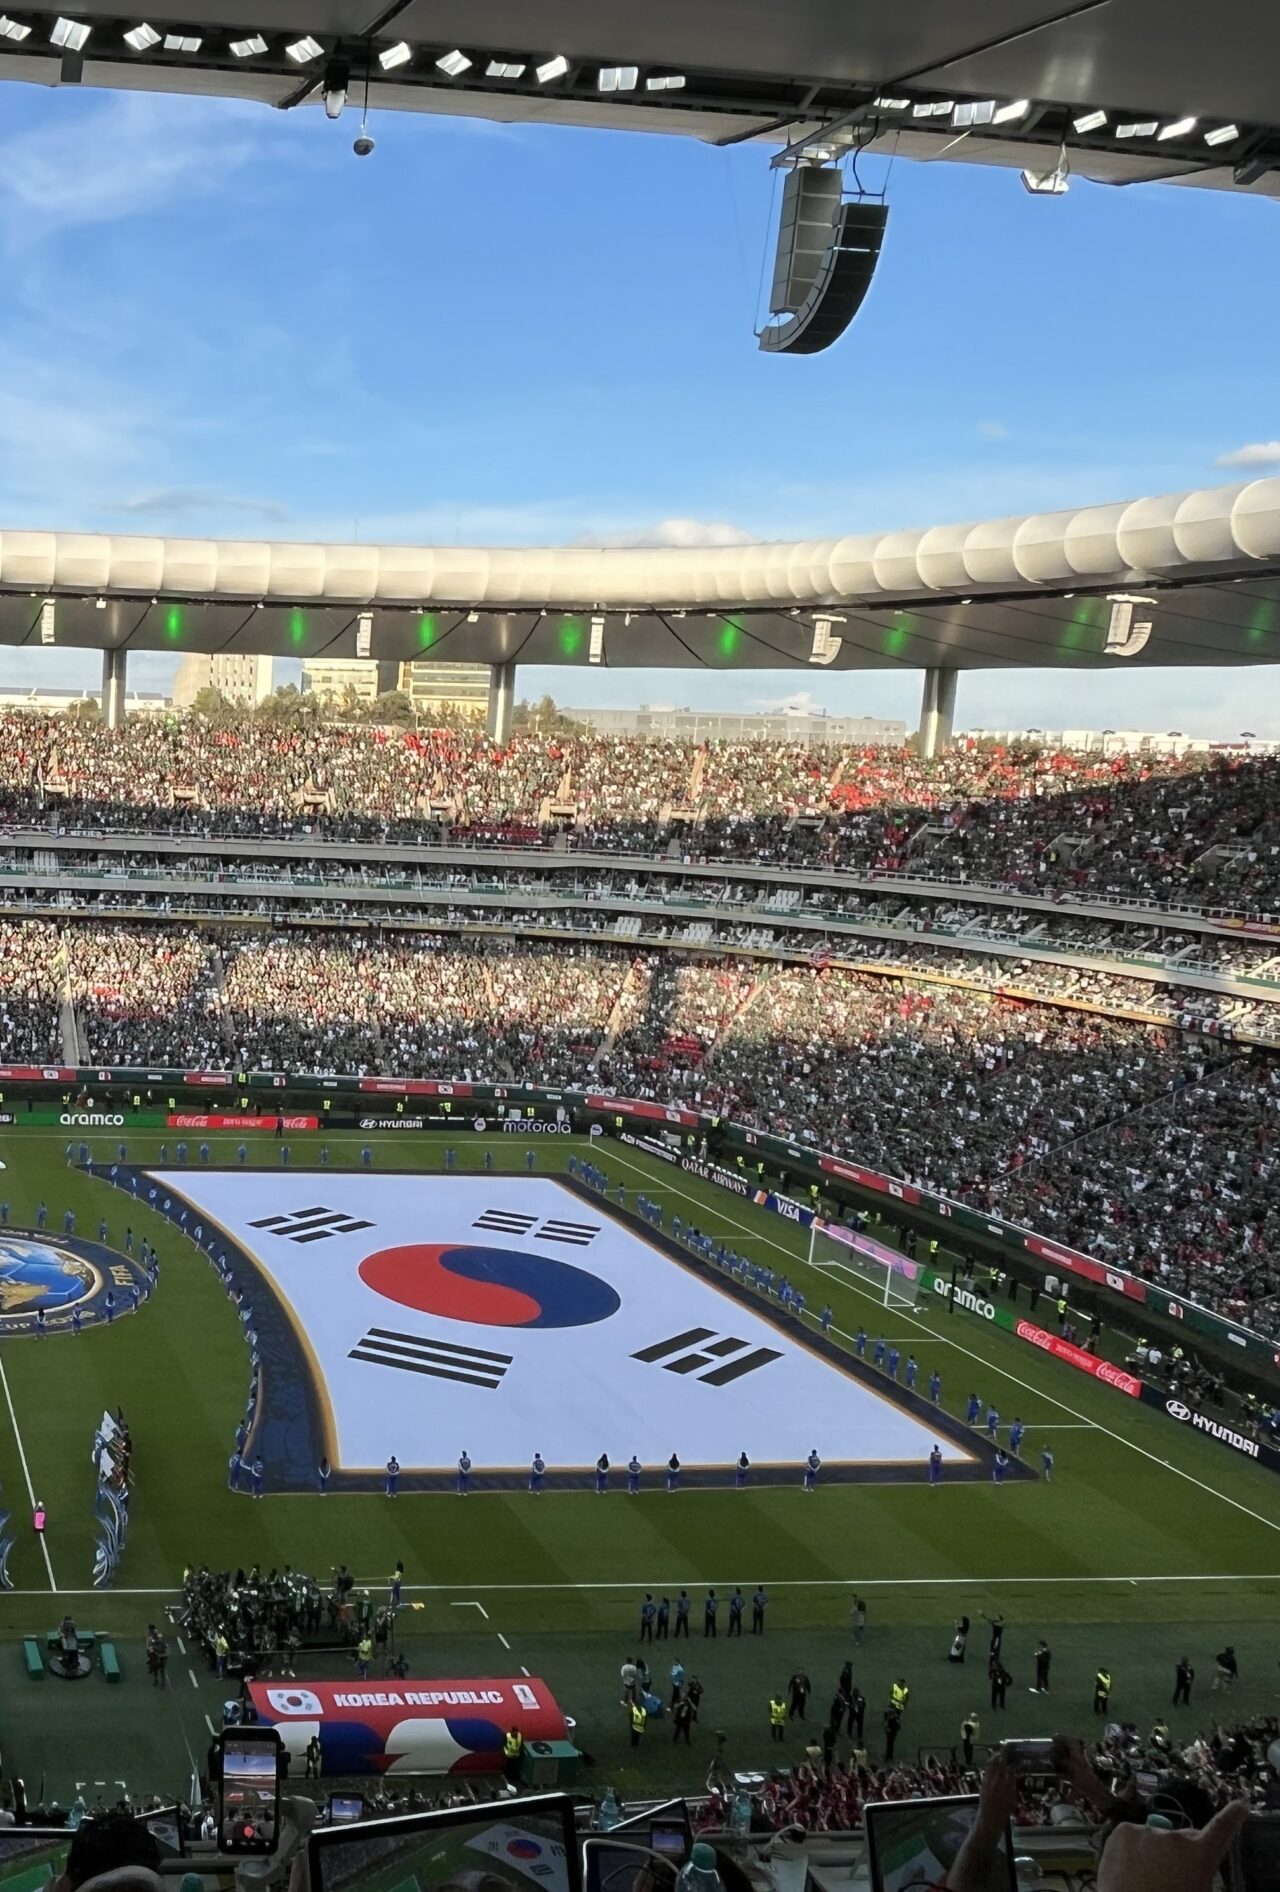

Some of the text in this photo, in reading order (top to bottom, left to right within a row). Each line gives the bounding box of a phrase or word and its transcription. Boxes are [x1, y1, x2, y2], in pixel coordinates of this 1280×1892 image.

[59, 1113, 125, 1126] aramco
[378, 1120, 423, 1130] HYUNDAI
[503, 1119, 572, 1134] motorola
[776, 1198, 801, 1223] VISA
[933, 1277, 996, 1320] aramco
[1192, 1413, 1260, 1458] HYUNDAI
[332, 1690, 505, 1708] KOREA REPUBLIC
